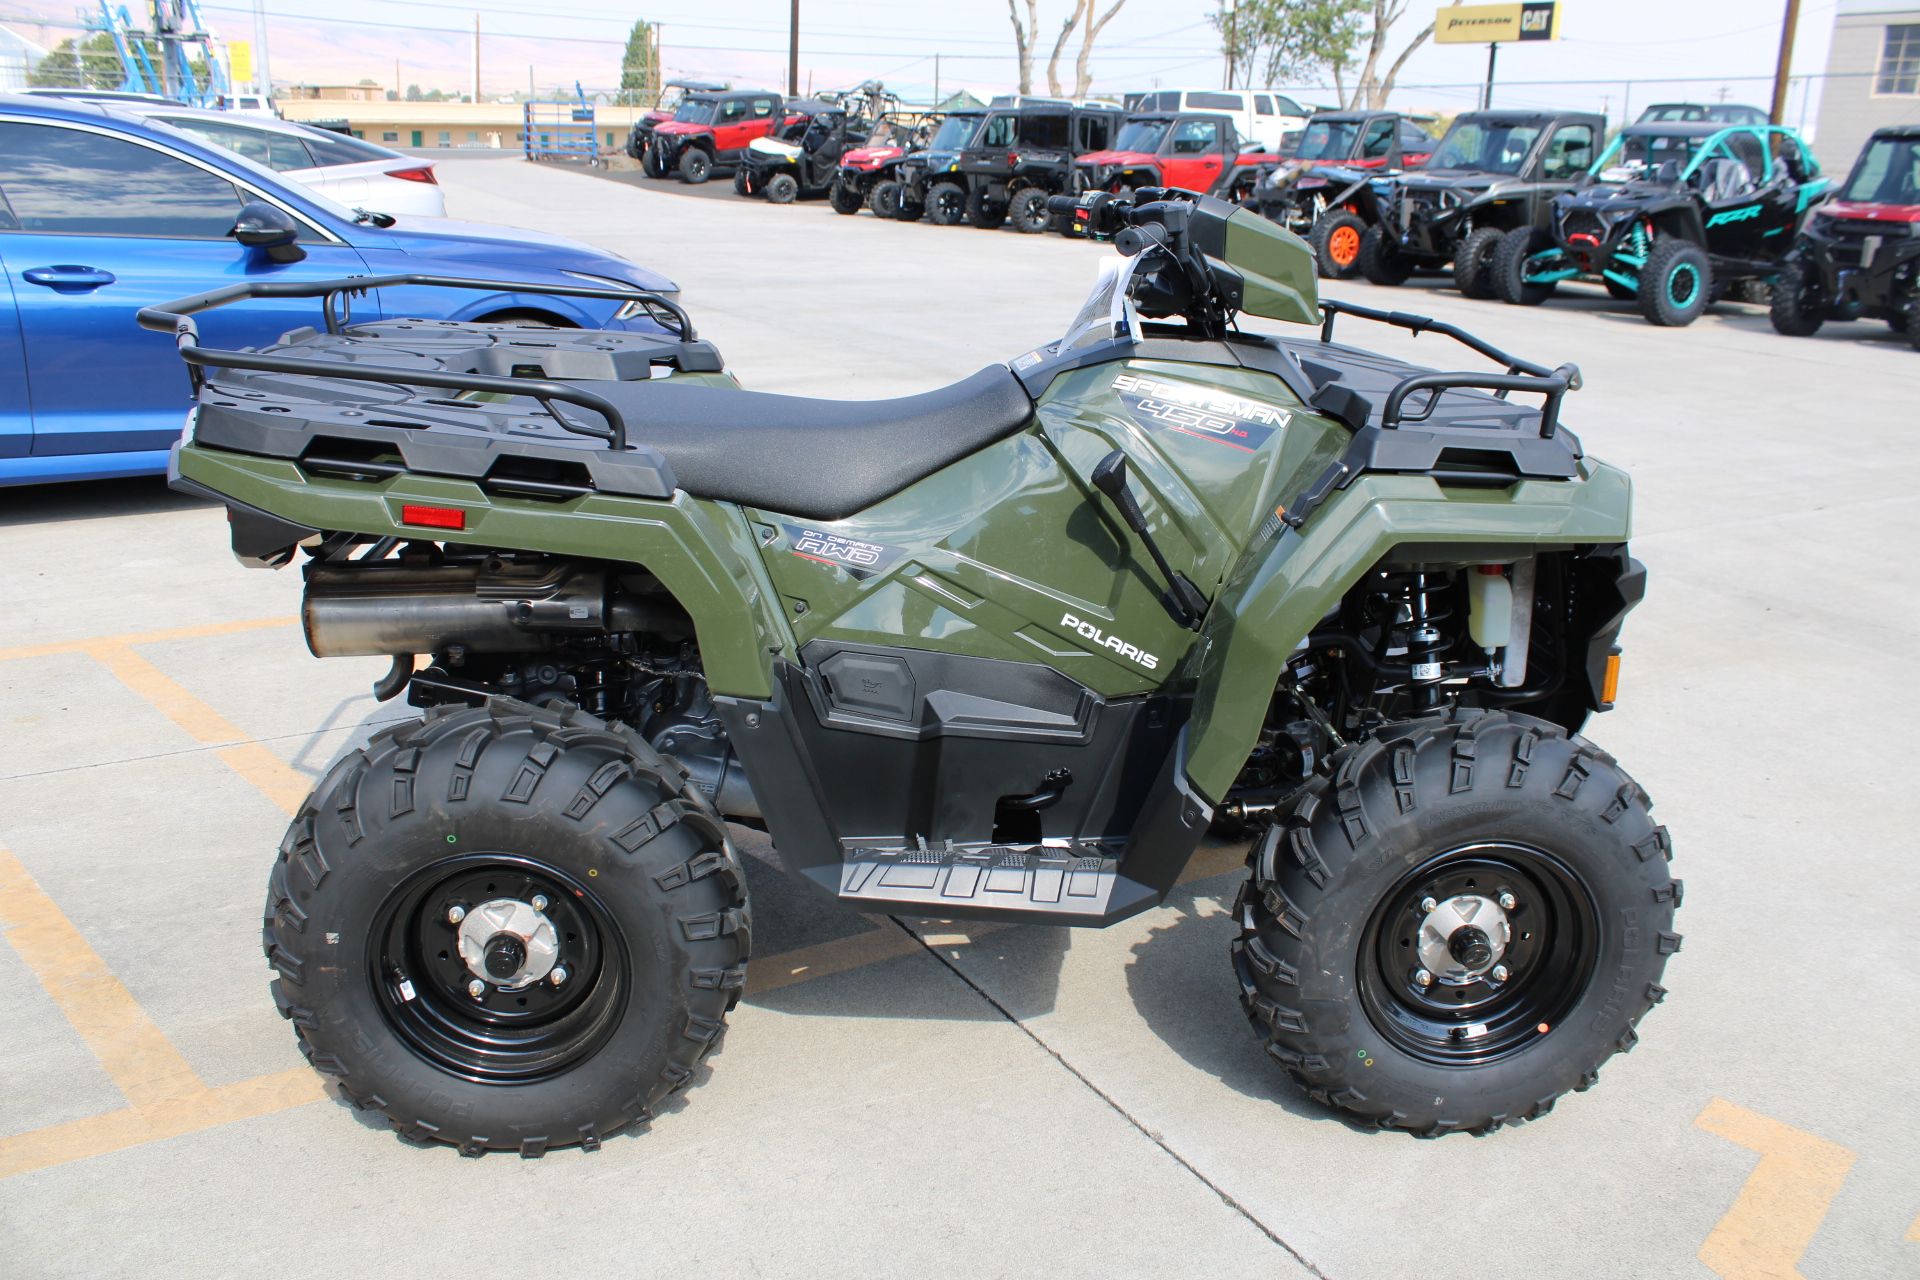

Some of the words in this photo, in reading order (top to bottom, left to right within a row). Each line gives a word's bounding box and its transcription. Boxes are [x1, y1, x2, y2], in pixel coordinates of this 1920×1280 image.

[1448, 17, 1512, 30] PETERSON
[1522, 10, 1551, 31] CAT
[1112, 375, 1292, 427] SPOTSMAN
[1138, 400, 1235, 434] 450
[796, 537, 879, 565] AWD
[827, 535, 883, 552] DEMAND
[1061, 613, 1159, 670] POLARIS
